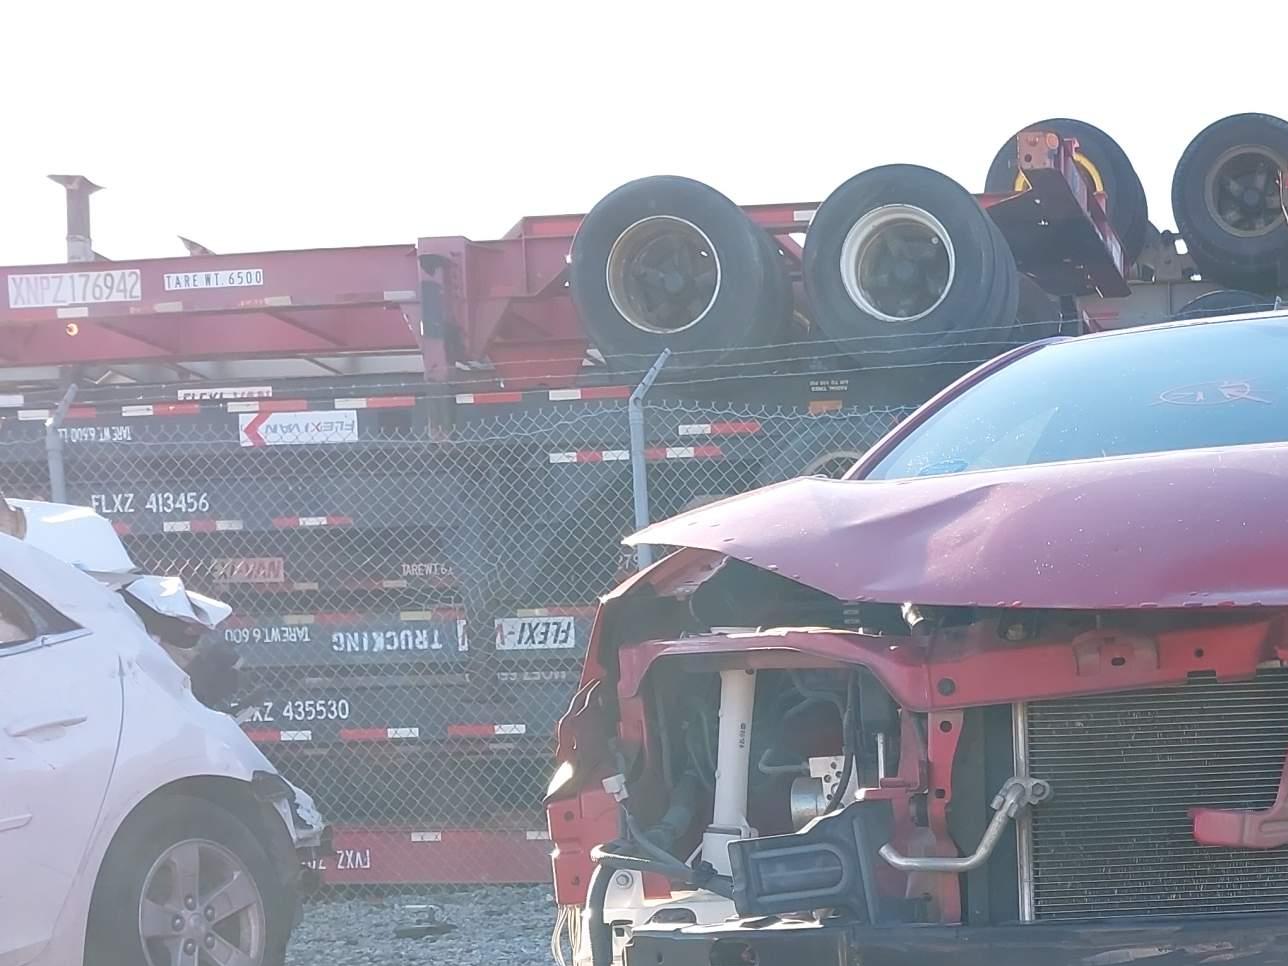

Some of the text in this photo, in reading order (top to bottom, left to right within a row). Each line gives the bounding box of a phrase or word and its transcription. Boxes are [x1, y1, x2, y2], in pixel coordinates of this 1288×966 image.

[166, 273, 204, 290] TARE
[227, 270, 263, 286] 6500
[265, 422, 299, 435] VAN
[91, 492, 209, 514] FLXZ 413456
[332, 629, 443, 652] TRUCKING
[282, 698, 349, 721] 435530
